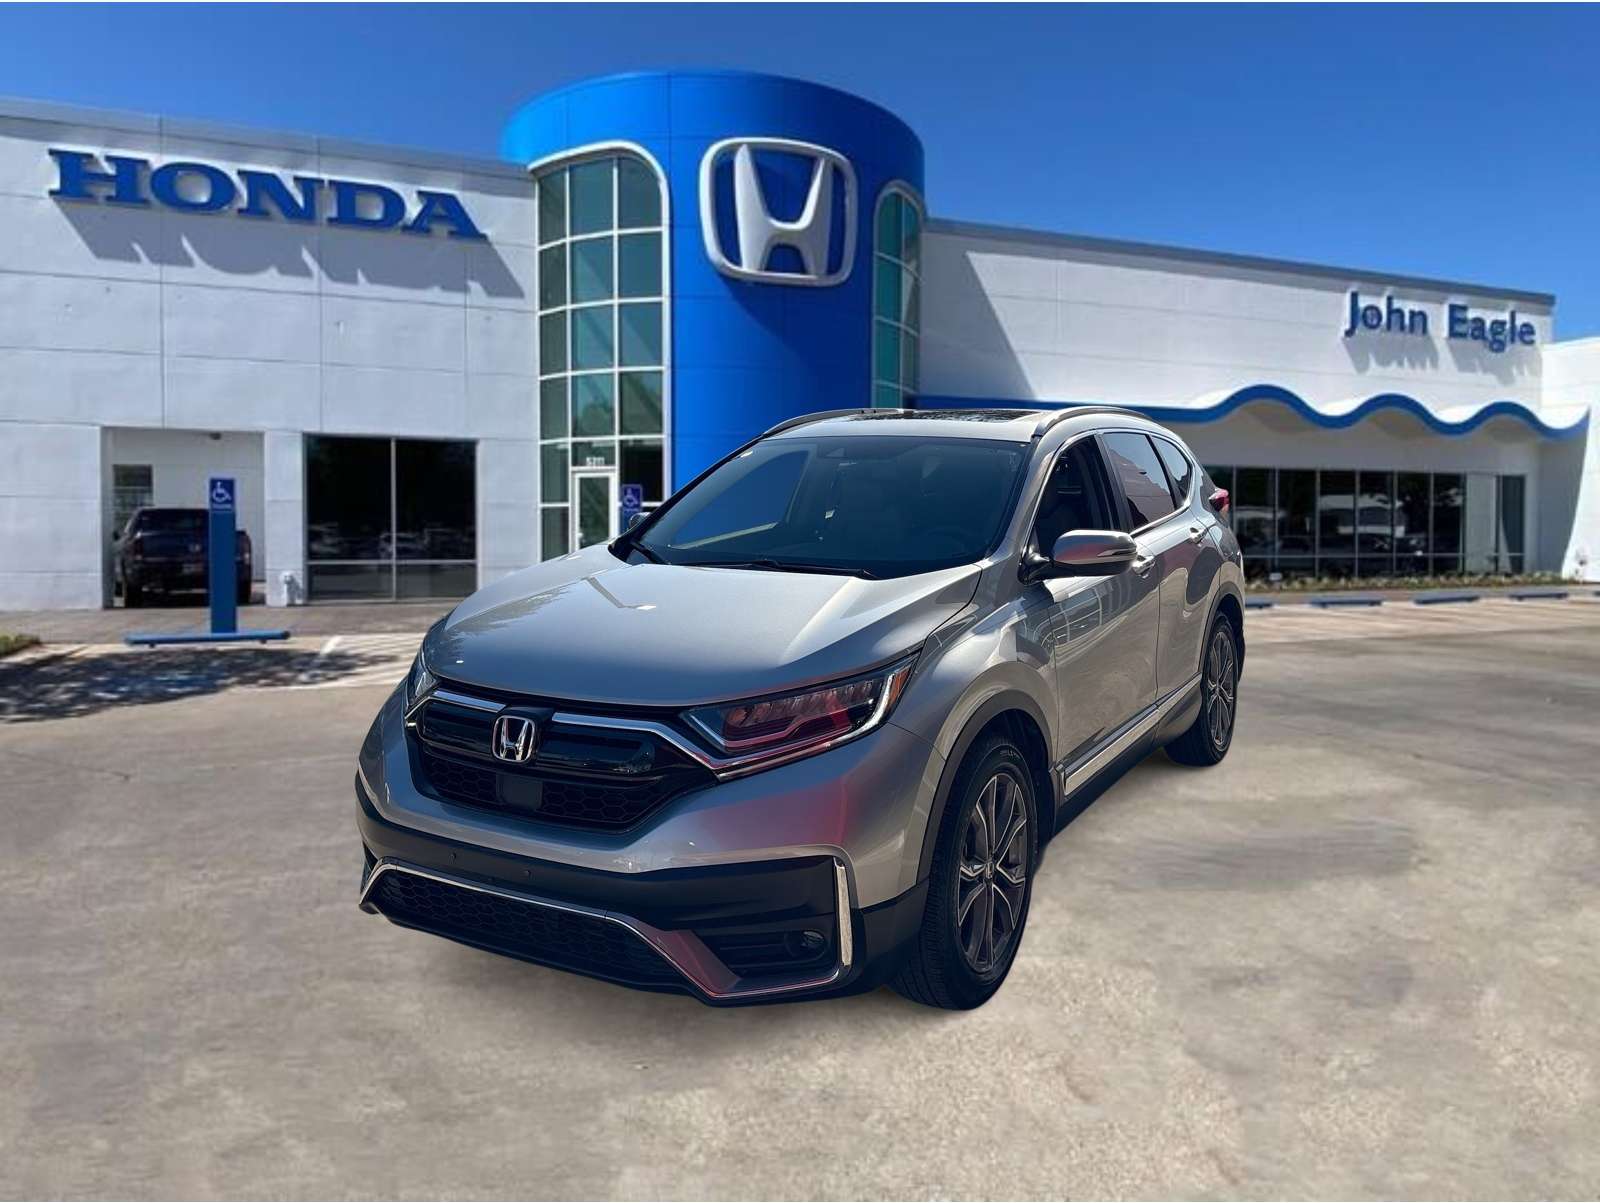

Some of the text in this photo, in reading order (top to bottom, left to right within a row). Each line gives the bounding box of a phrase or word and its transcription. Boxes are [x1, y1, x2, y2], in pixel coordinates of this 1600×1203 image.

[48, 148, 489, 239] HONDA
[1344, 291, 1536, 353] John Eagle
